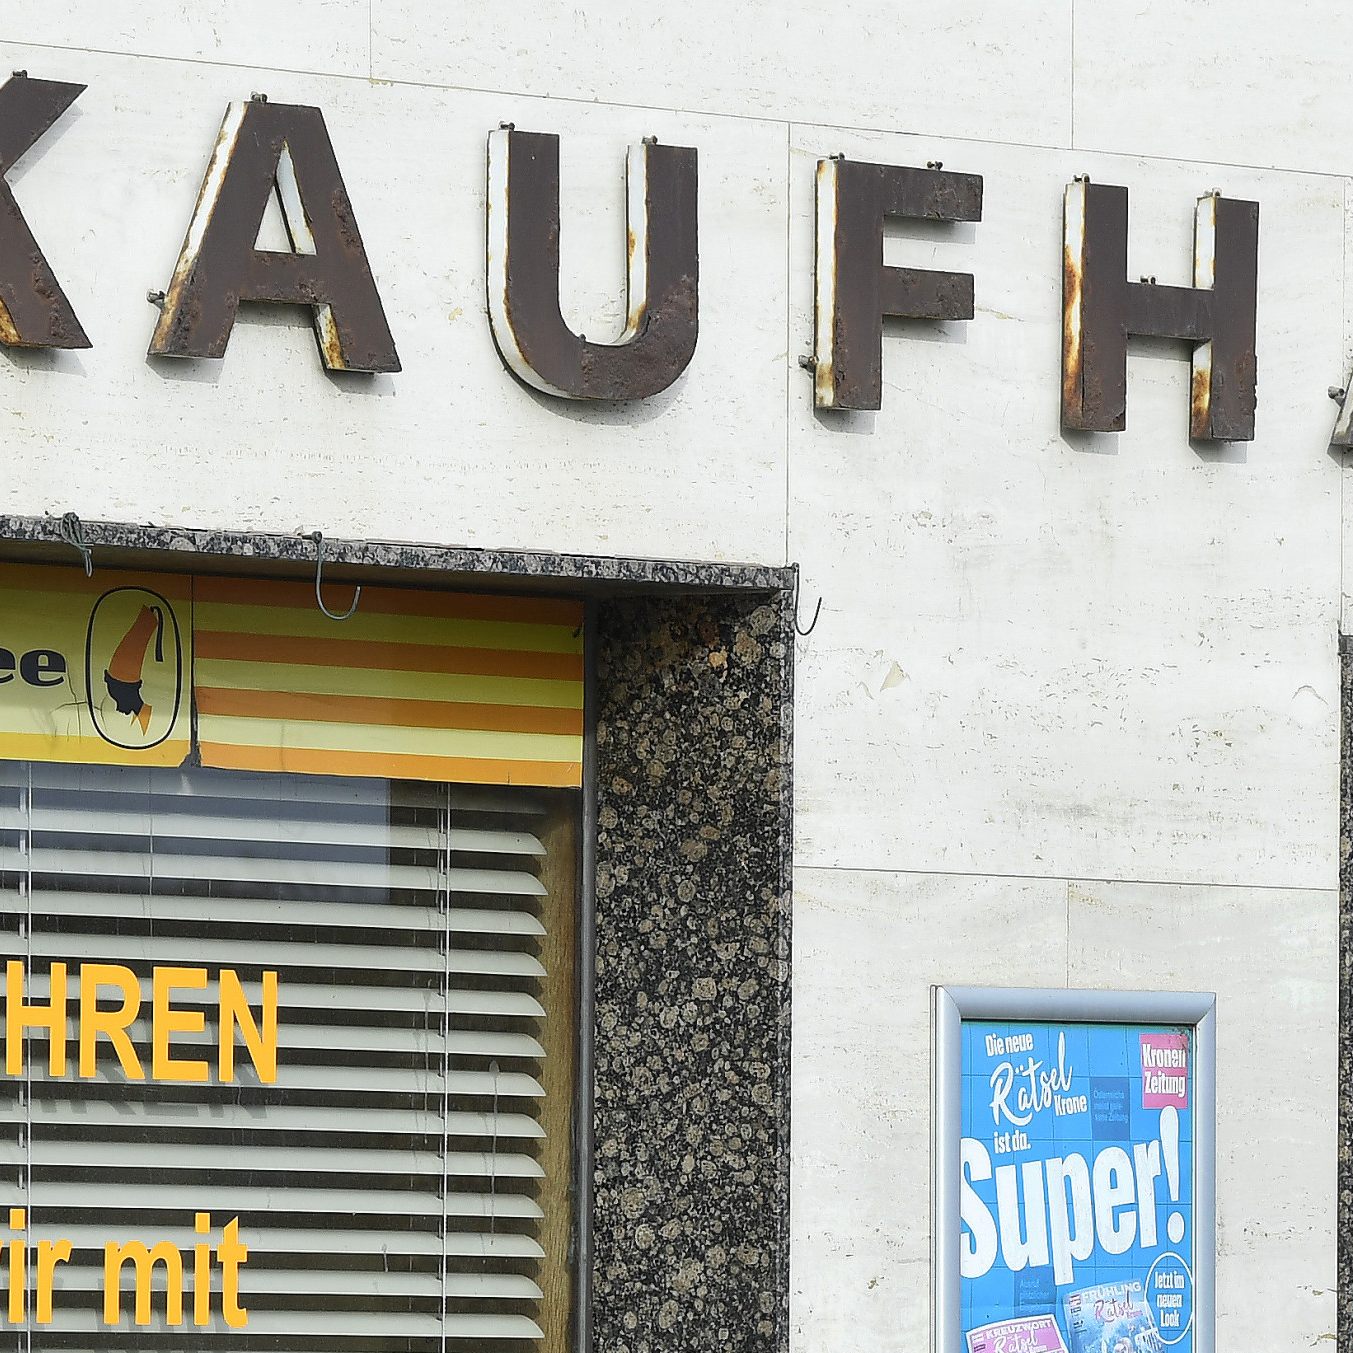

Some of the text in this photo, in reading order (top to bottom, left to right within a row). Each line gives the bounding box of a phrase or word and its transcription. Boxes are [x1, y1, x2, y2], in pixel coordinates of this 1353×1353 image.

[5, 960, 278, 1083] HREN
[985, 1033, 1034, 1056] Die neue
[1142, 1043, 1186, 1068] Kronen
[989, 1031, 1073, 1126] Rätsel
[1144, 1071, 1186, 1098] Zeitung
[1055, 1094, 1087, 1116] Krone
[994, 1130, 1031, 1153] ist da.
[960, 1105, 1185, 1286] Super!
[0, 1208, 248, 1328] ir mit
[1155, 1271, 1185, 1289] Jetzt im
[1157, 1294, 1182, 1308] neuen
[986, 1319, 1052, 1340] KREUZWORT
[1160, 1310, 1179, 1327] Look
